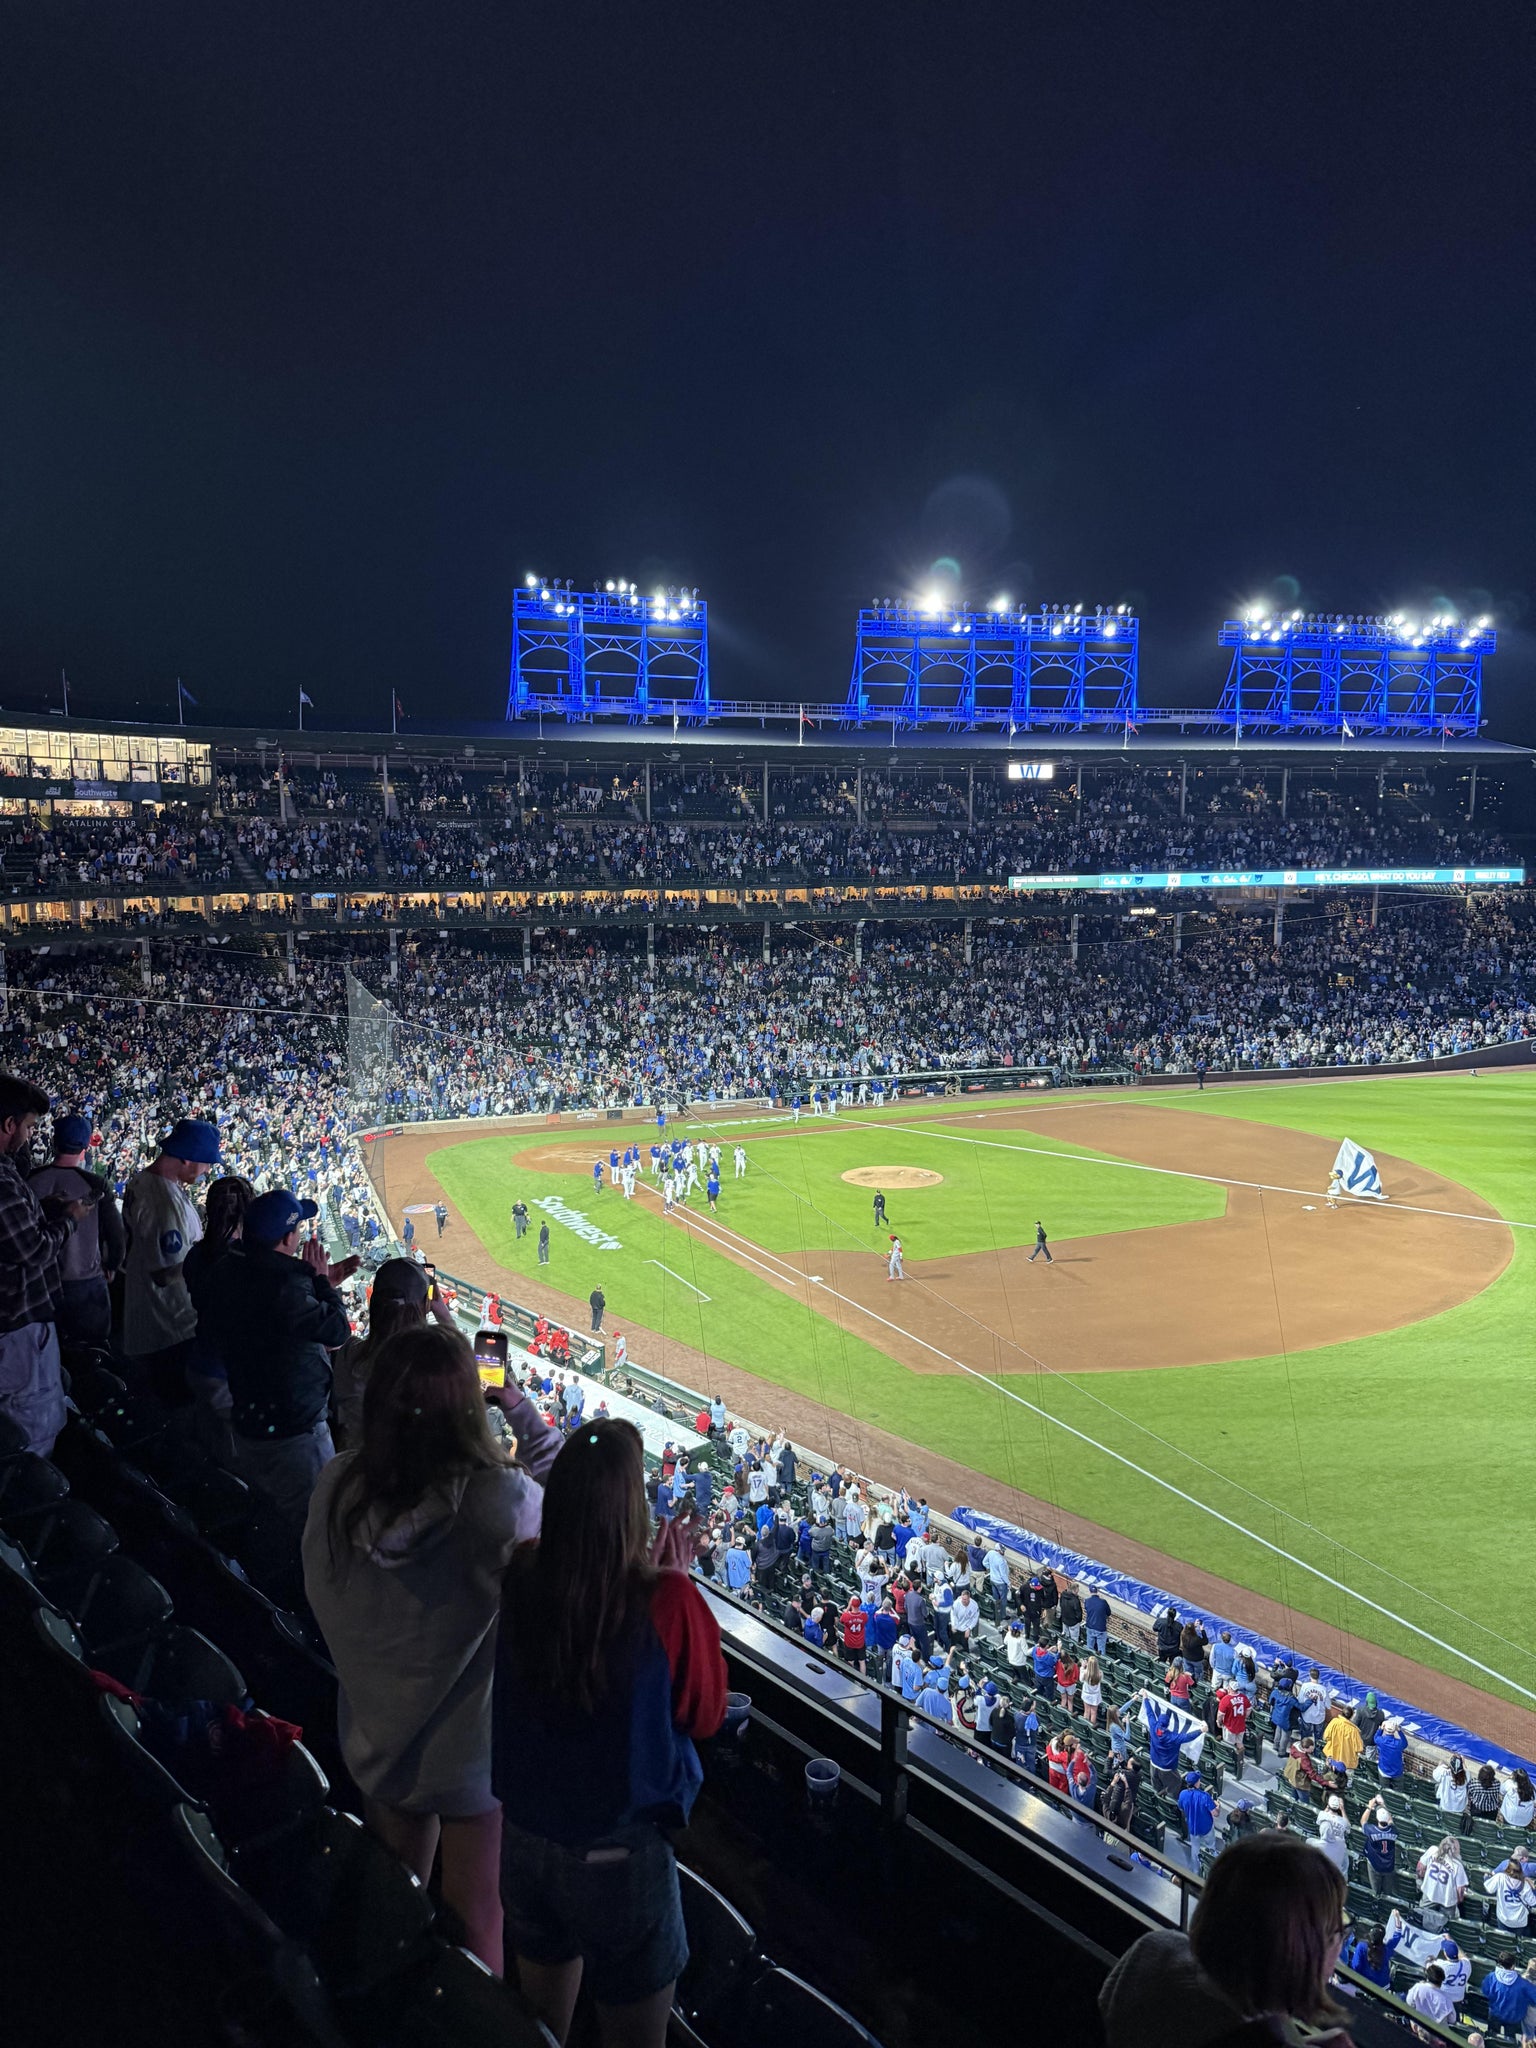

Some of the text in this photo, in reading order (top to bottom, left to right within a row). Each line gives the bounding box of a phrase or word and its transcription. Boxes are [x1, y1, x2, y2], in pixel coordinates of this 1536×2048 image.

[1019, 764, 1041, 779] W
[74, 788, 114, 797] Southwest
[584, 790, 598, 800] W
[615, 791, 628, 800] W
[62, 819, 137, 828] CATALINA CLUB
[120, 854, 134, 865] W
[1370, 872, 1392, 881] WHAT
[1392, 872, 1405, 881] DO
[1405, 872, 1421, 881] YOU
[1421, 871, 1436, 880] SAY
[280, 1070, 295, 1081] W
[1346, 1151, 1382, 1195] W
[530, 1195, 619, 1245] Southwest
[736, 1435, 743, 1444] 2
[752, 1479, 763, 1489] 17
[850, 1623, 861, 1633] 44
[1233, 1704, 1245, 1718] 14
[1381, 1840, 1388, 1854] 1
[1429, 1863, 1450, 1885] 23
[1445, 1973, 1467, 1987] 23
